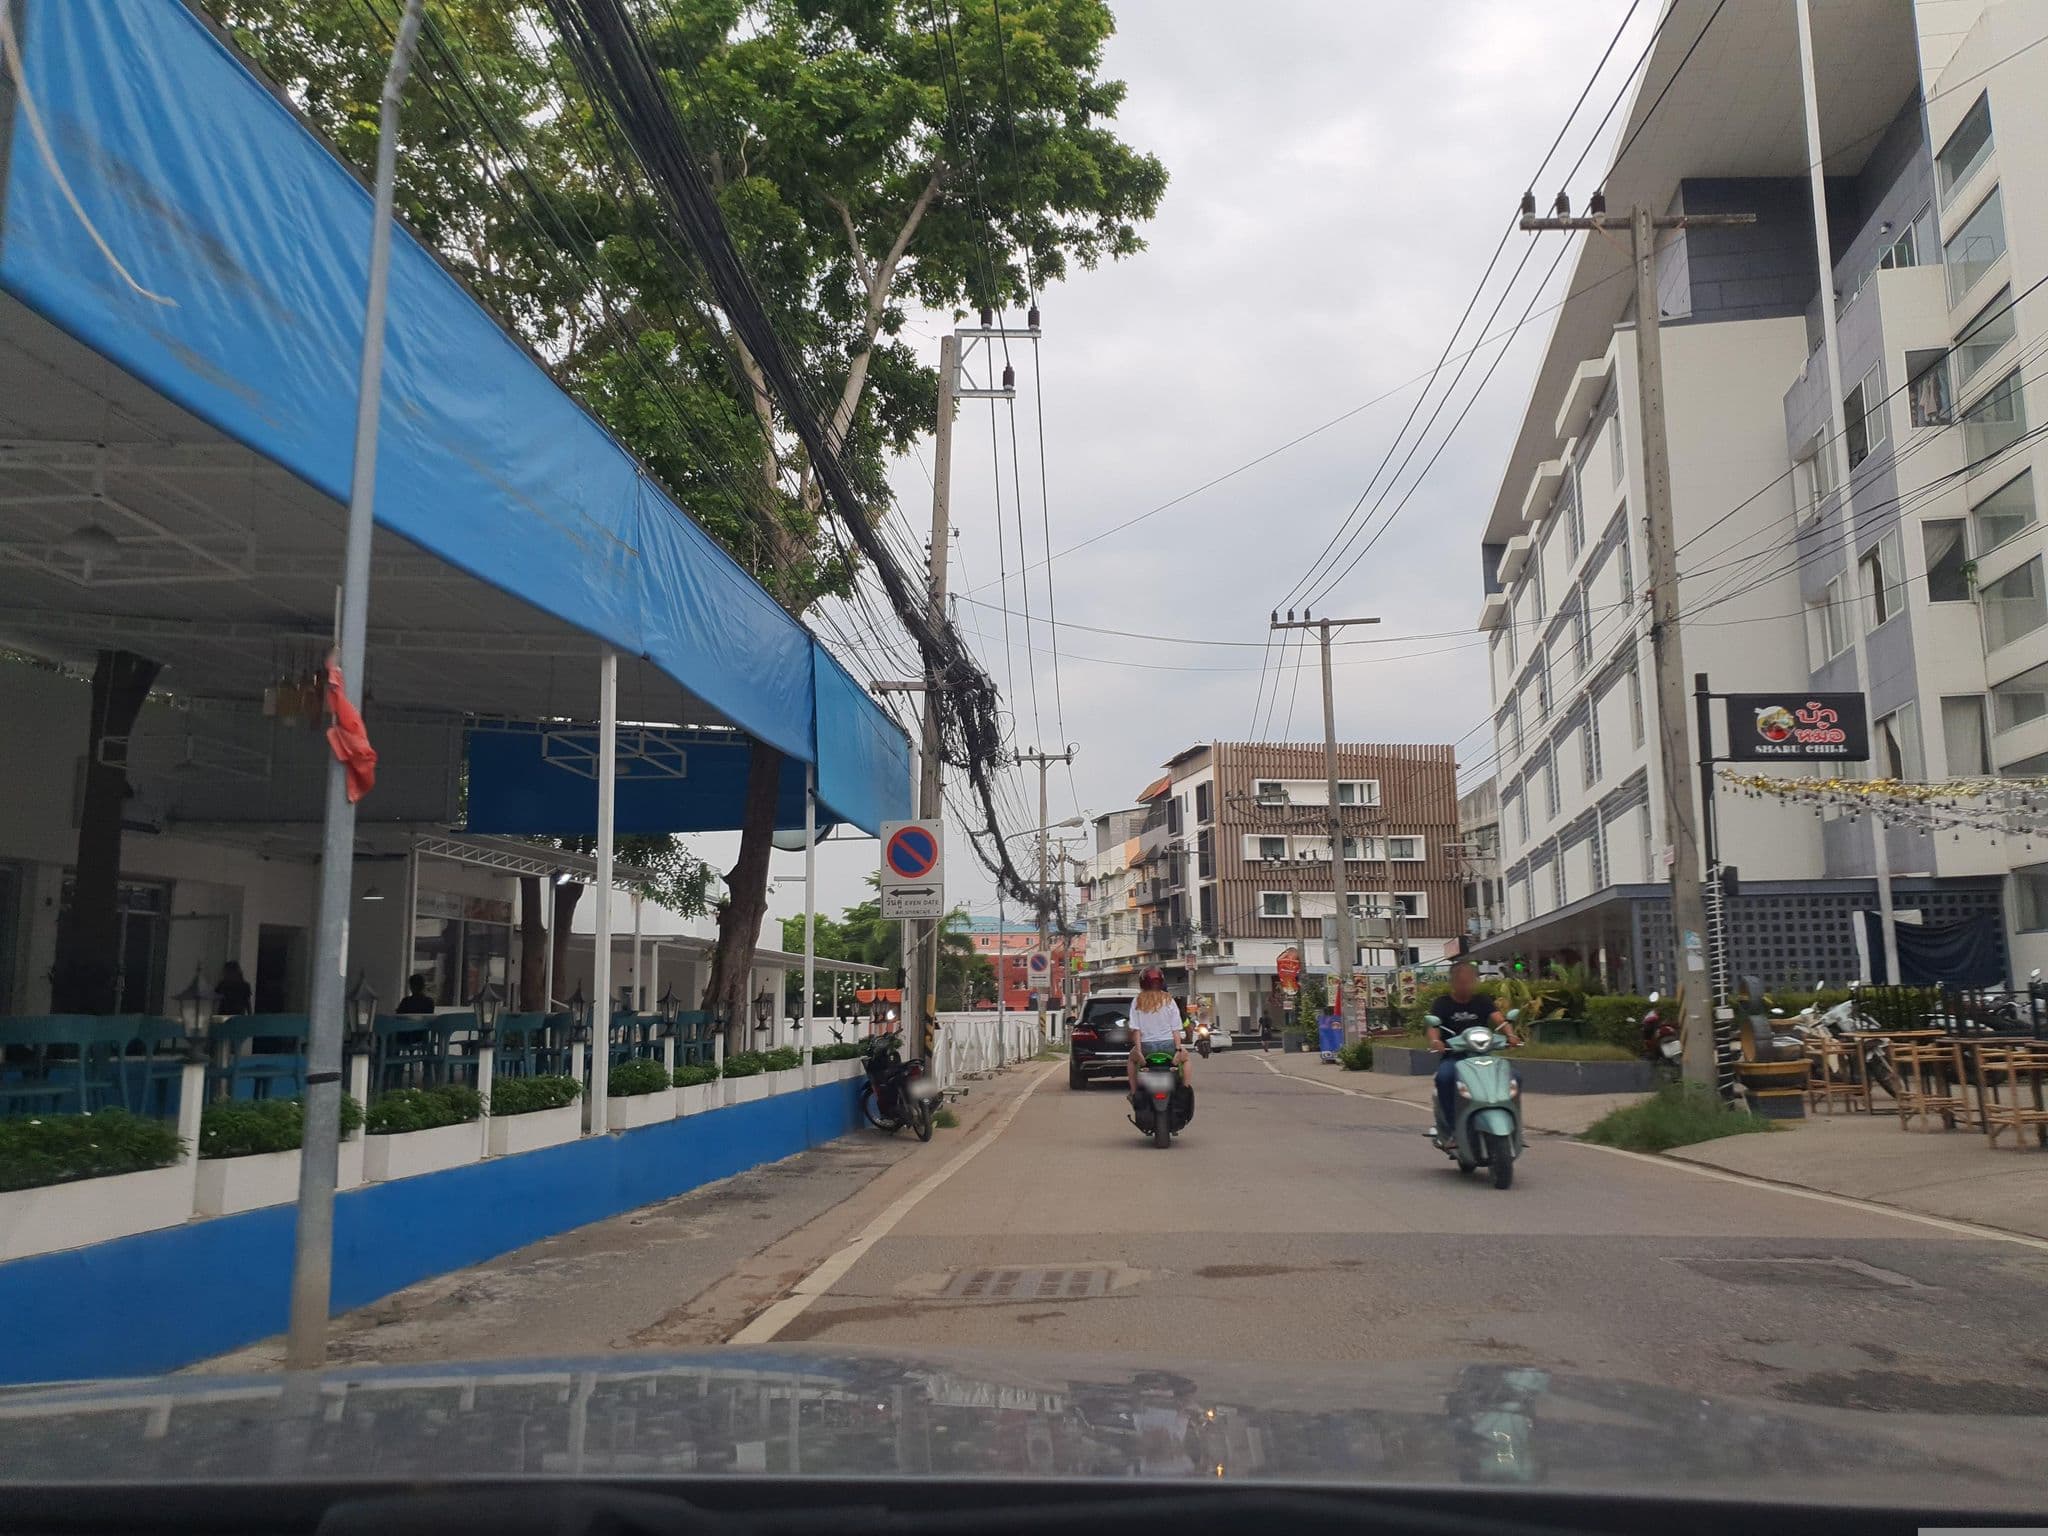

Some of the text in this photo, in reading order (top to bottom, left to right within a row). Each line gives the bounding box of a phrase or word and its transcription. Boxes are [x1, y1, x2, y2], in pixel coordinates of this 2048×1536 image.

[1794, 721, 1846, 743] หม้อ
[1754, 744, 1848, 753] SHABU CHILL
